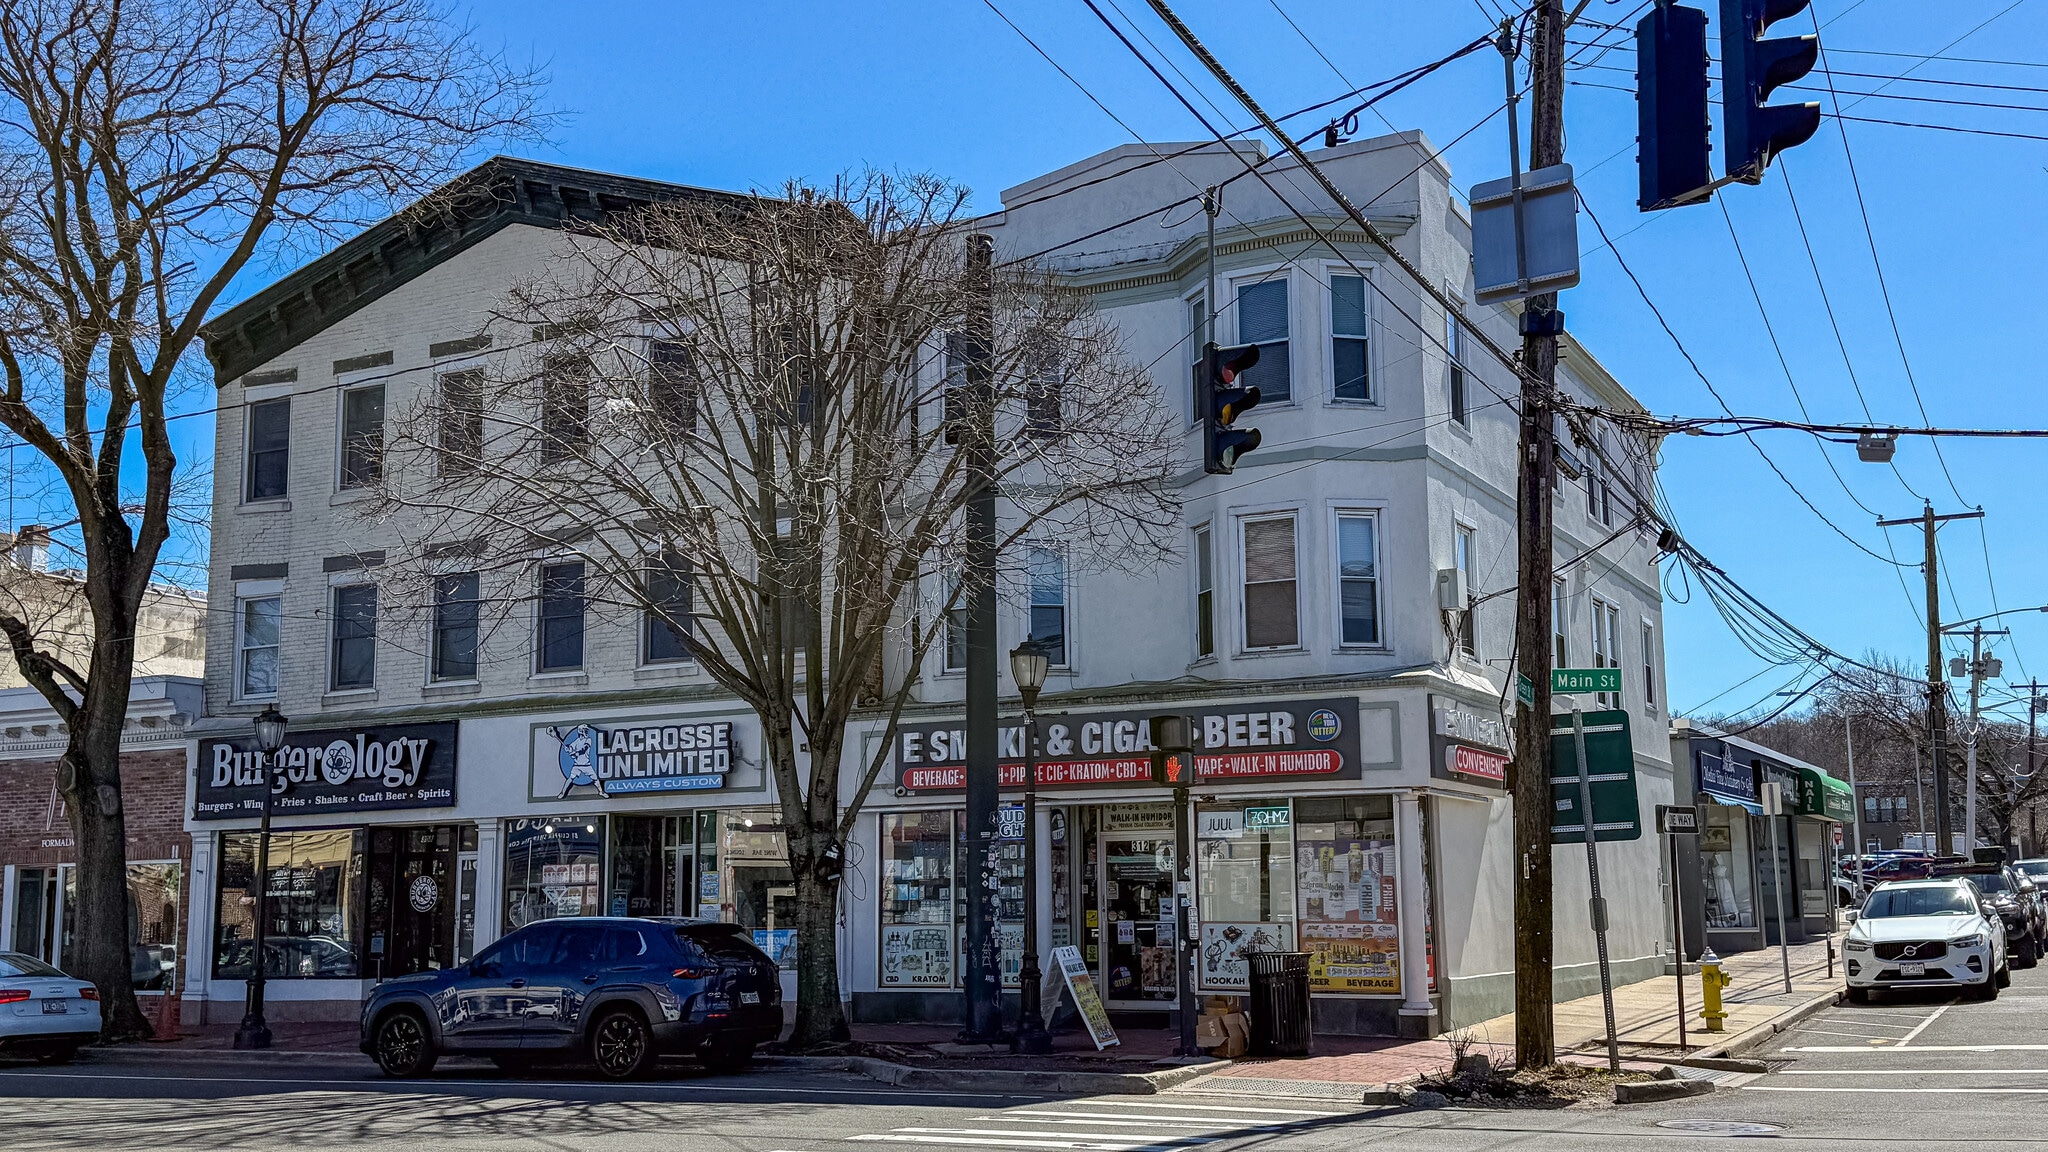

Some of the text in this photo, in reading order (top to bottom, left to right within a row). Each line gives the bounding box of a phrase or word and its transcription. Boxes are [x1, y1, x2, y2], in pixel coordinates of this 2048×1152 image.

[1557, 674, 1615, 687] Main St
[903, 711, 1297, 763] E SMKE & CIGA BEER
[1311, 726, 1337, 736] LOTTERY
[597, 723, 729, 755] LACROSSE
[598, 748, 730, 779] UNLIMITED
[912, 768, 960, 788] BEVERAGE
[1009, 763, 1027, 784] PIP
[1069, 758, 1110, 780] KRATOM
[1116, 762, 1137, 778] CBD
[1196, 757, 1224, 776] VAPE
[1230, 754, 1277, 774] WALK-IN
[1280, 751, 1331, 772] HUMIDOR
[1456, 748, 1505, 777] CONVENIENC
[607, 776, 722, 791] ALWAYS CUSTOM
[198, 788, 450, 814] Burgers Win Fries Shakes Craft Beer Spirits
[1804, 780, 1815, 812] NAIL
[1110, 812, 1173, 823] WALK-IN HUMIDOR
[1677, 814, 1692, 826] WAY
[1208, 818, 1233, 832] JUUL
[41, 838, 75, 848] FORMALW
[1132, 840, 1150, 852] 312
[631, 897, 651, 909] STX
[1361, 884, 1374, 916] PRIME
[1382, 883, 1395, 913] PRIME
[885, 975, 946, 984] CBD KRATOM
[1205, 976, 1246, 985] HOOKAH
[1309, 978, 1394, 988] BEER BEVERAGE
